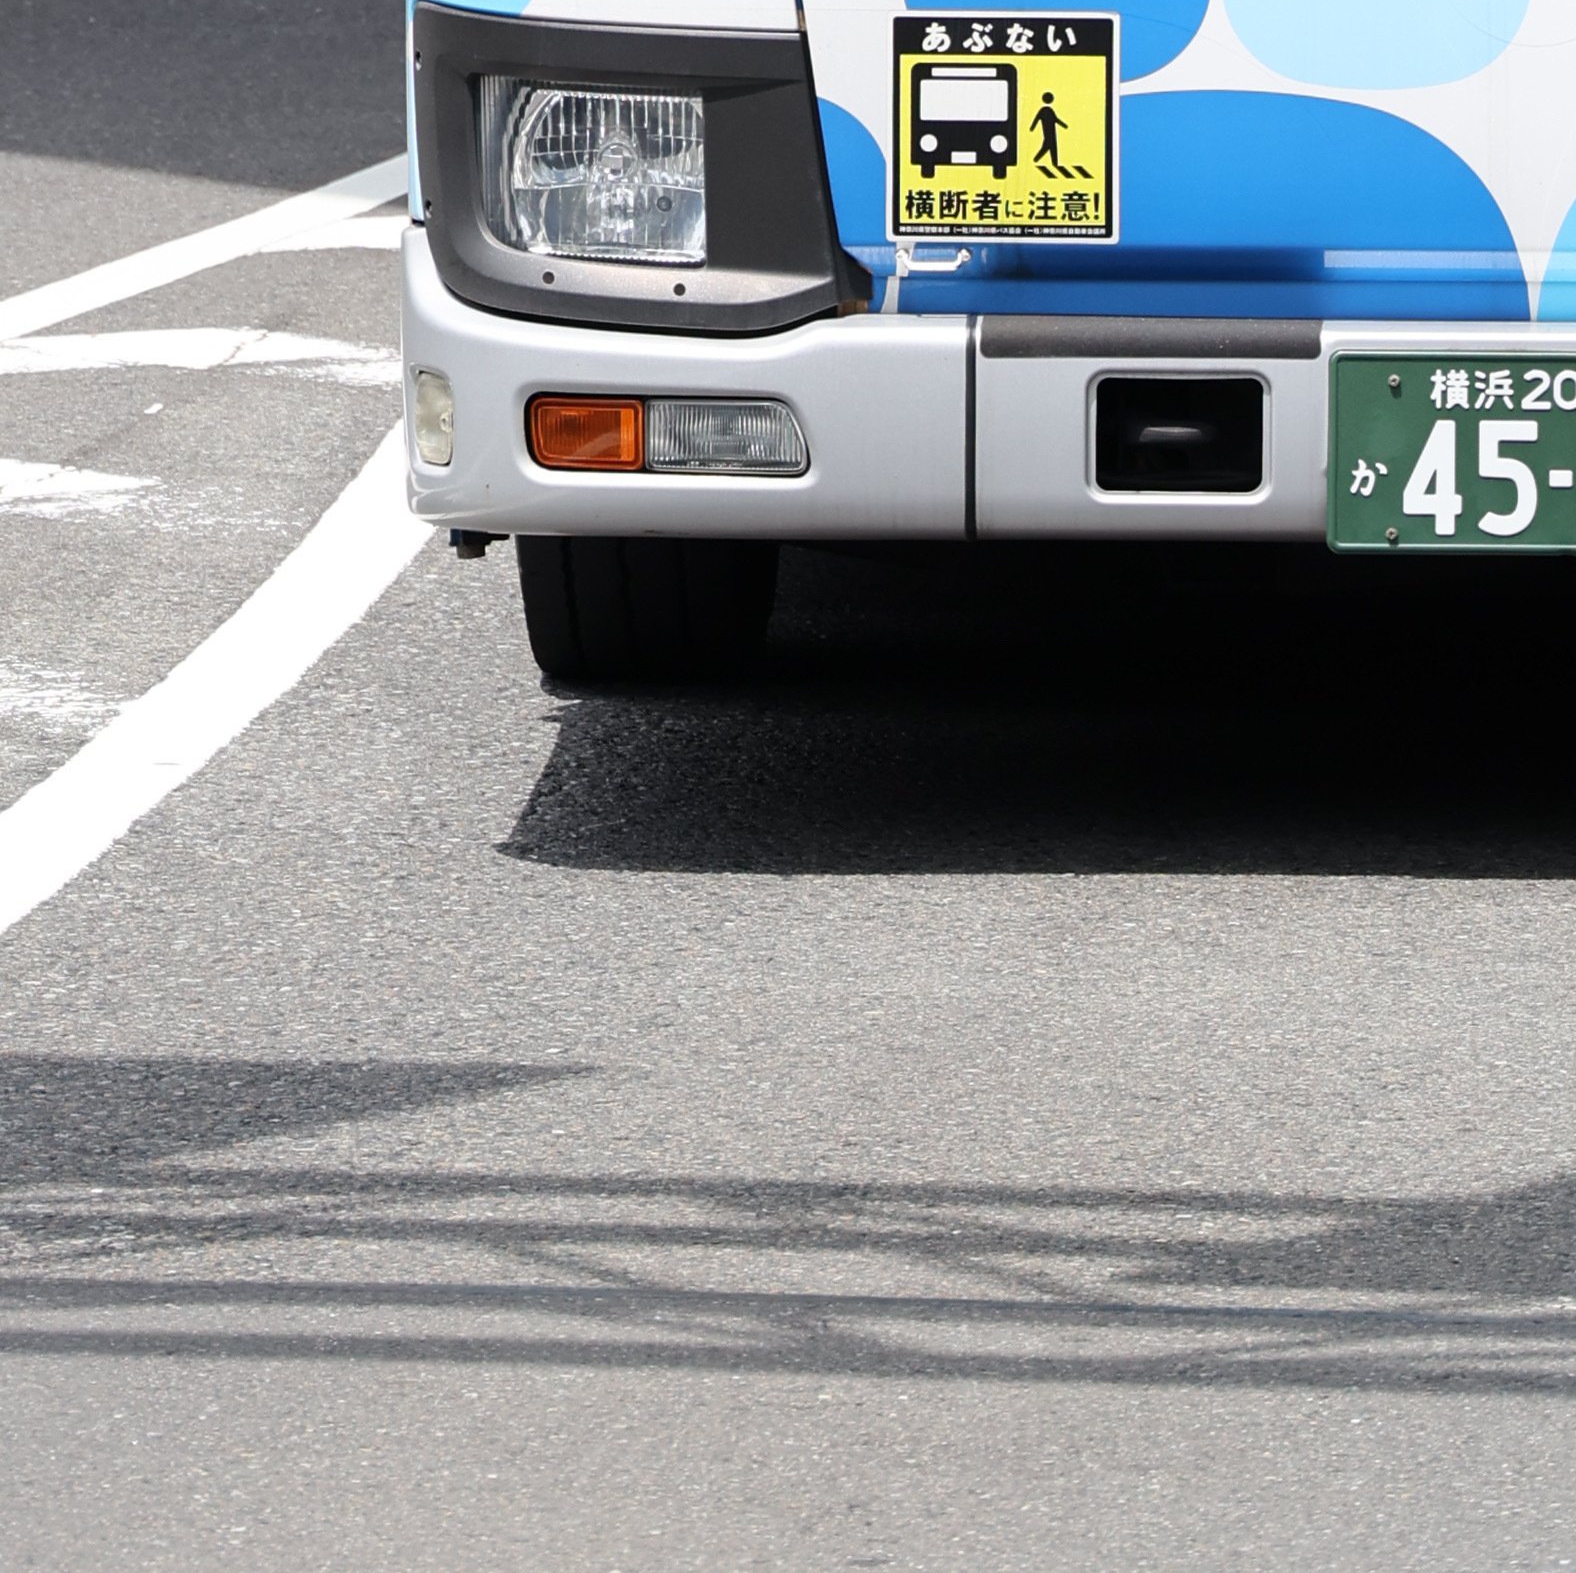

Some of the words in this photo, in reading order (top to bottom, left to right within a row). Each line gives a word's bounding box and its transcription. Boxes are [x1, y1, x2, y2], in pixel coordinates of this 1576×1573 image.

[921, 22, 1077, 53] あぶない
[905, 190, 1100, 221] 横断者に注意!
[1349, 458, 1388, 497] か
